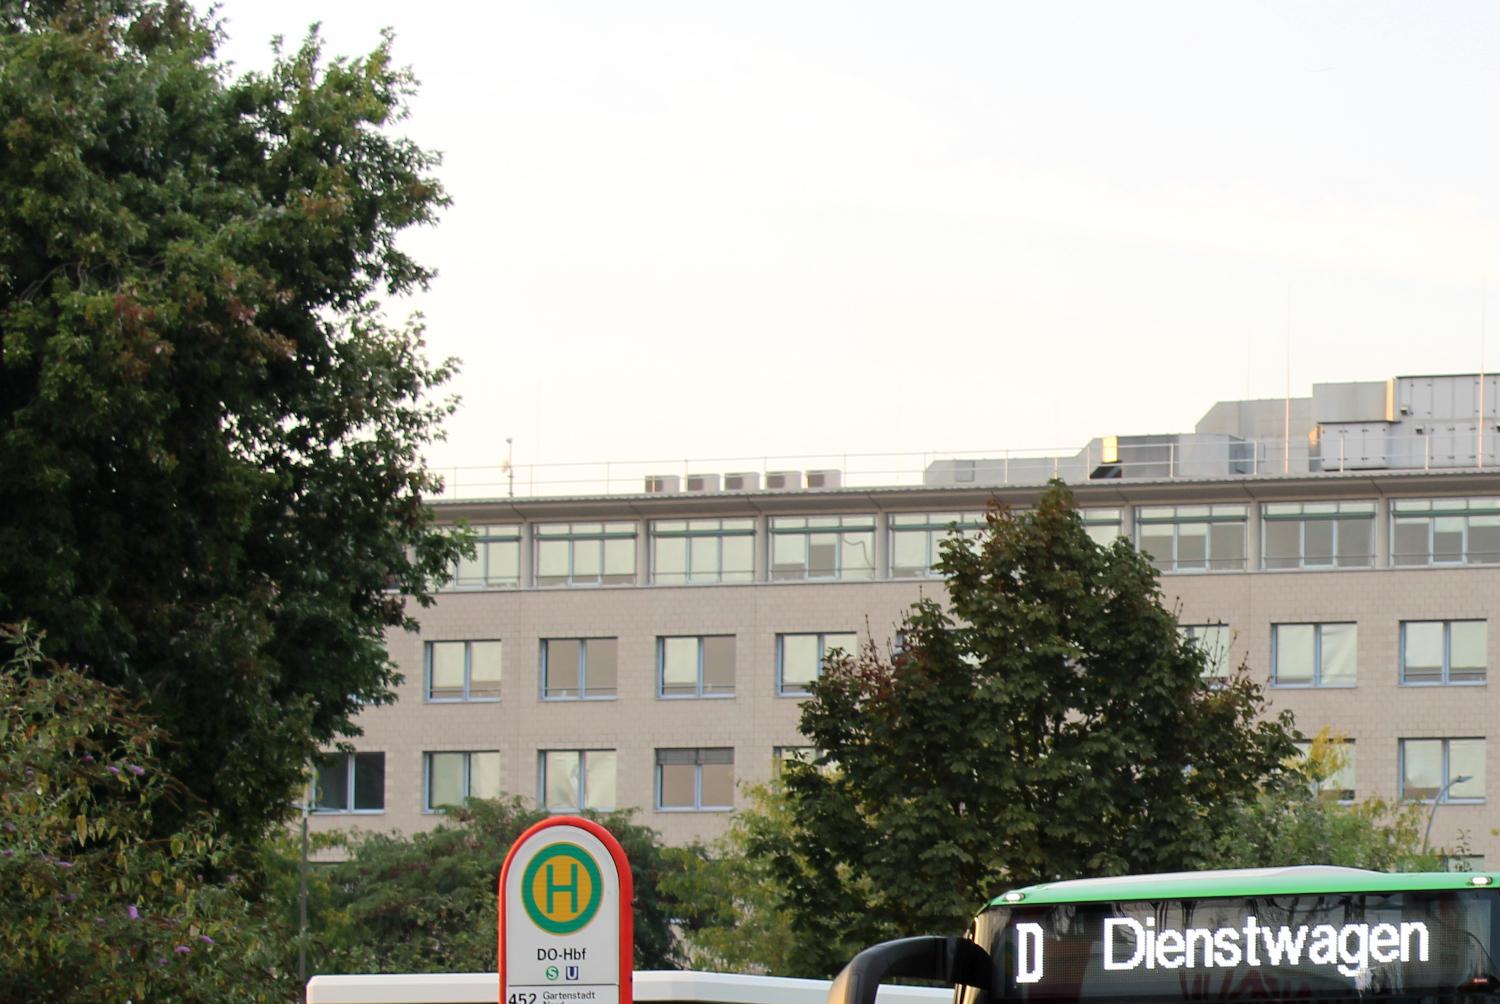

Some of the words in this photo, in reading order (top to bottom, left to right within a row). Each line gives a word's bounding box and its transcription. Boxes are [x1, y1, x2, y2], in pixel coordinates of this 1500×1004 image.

[546, 863, 578, 914] H
[537, 947, 587, 962] DO-Hbf
[1016, 922, 1044, 984] D
[1104, 915, 1430, 978] Dienstwagen
[543, 991, 596, 1000] Gartenstadt
